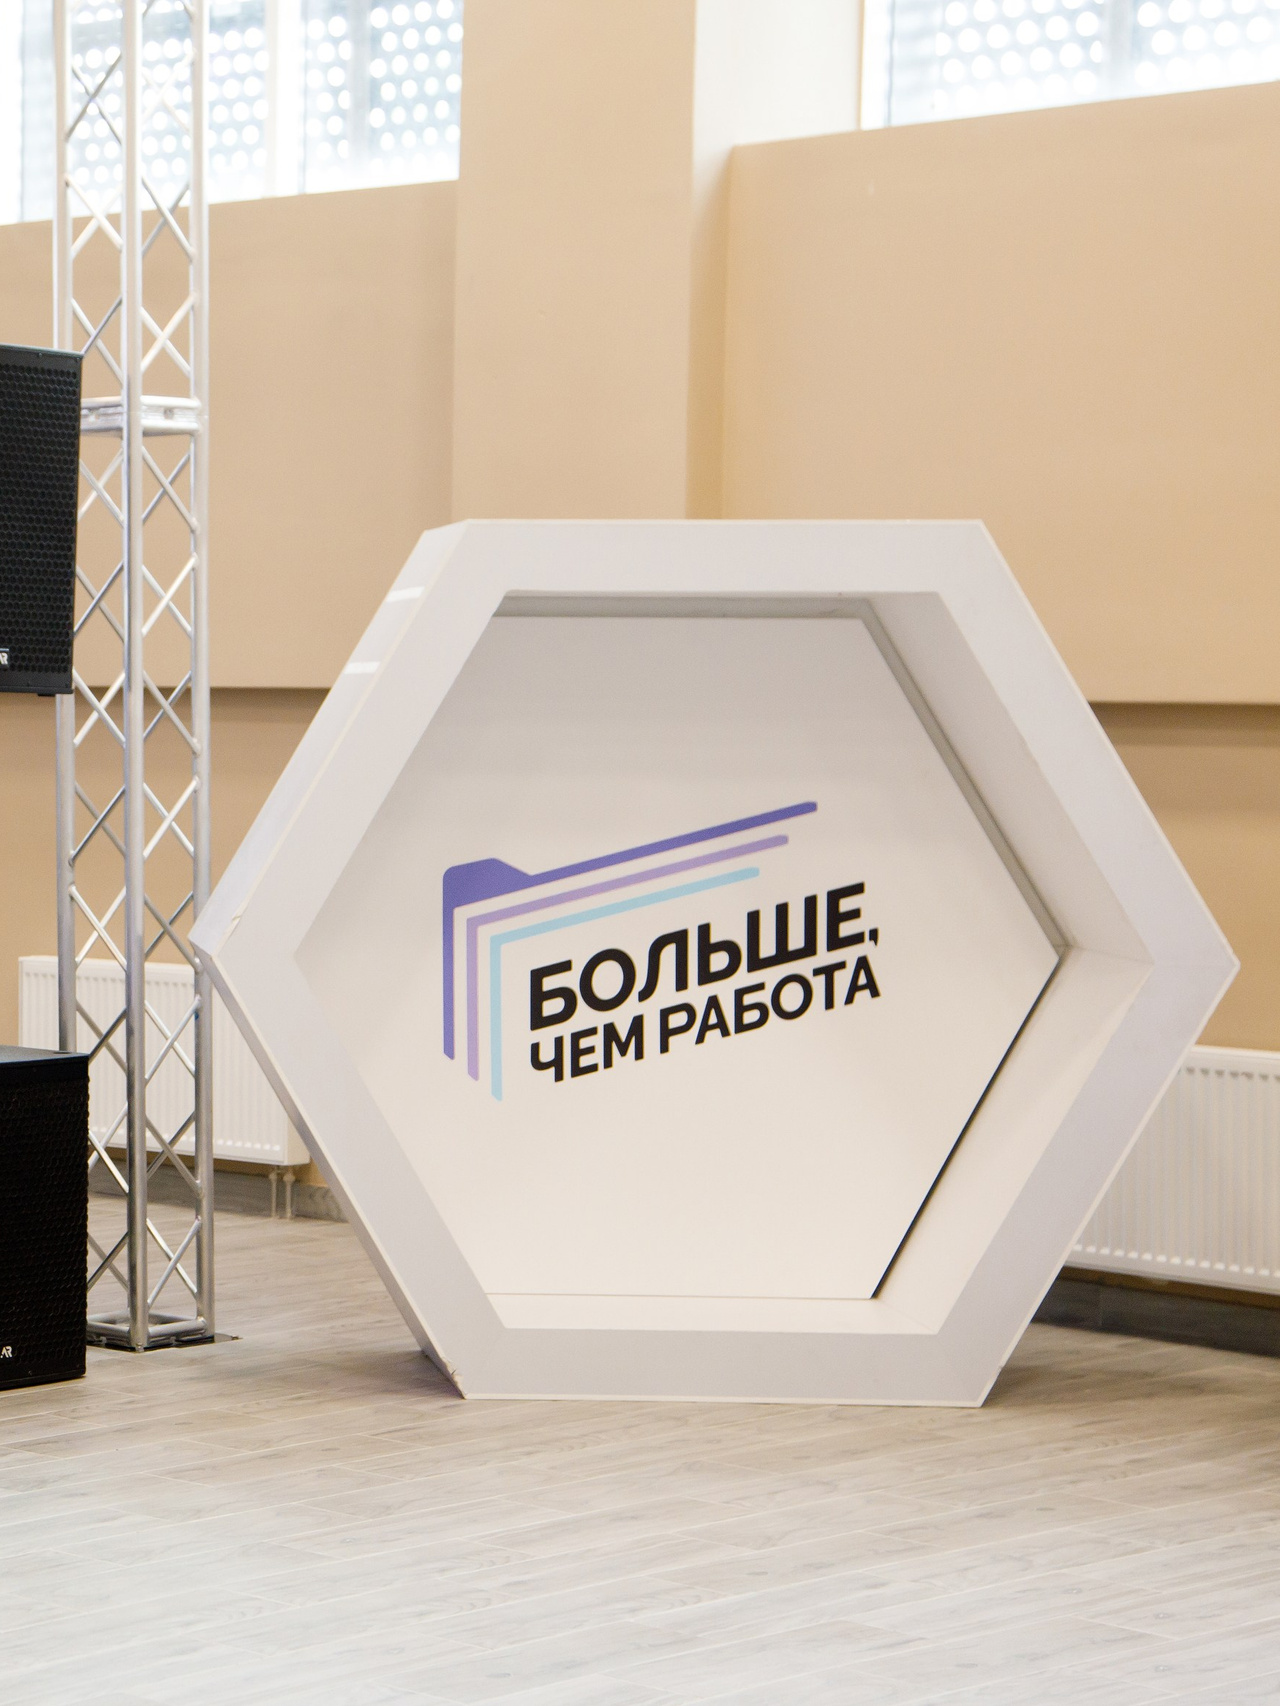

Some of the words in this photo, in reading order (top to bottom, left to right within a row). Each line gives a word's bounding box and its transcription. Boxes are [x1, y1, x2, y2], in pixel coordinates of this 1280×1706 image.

[530, 882, 879, 1032] БОЛЬШЕ,
[530, 1014, 644, 1083] ЧЕМ
[659, 955, 881, 1055] РАБОТА
